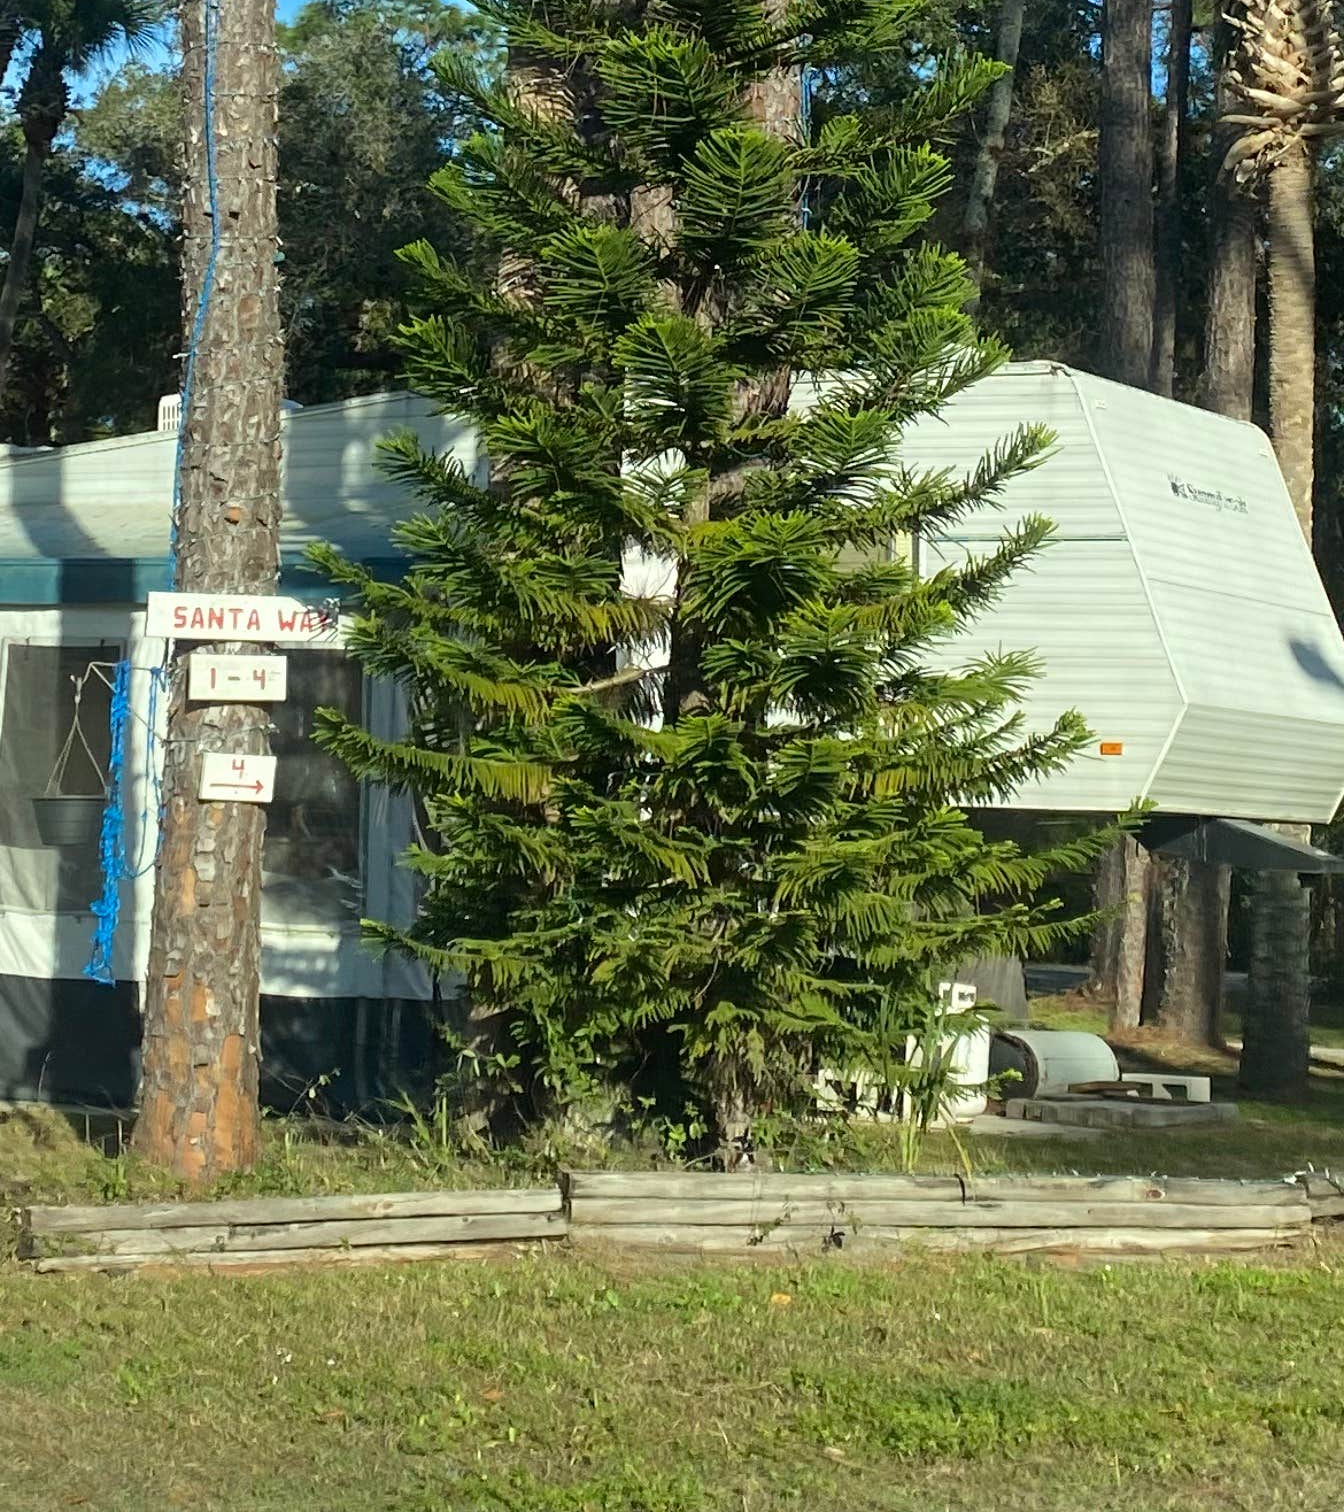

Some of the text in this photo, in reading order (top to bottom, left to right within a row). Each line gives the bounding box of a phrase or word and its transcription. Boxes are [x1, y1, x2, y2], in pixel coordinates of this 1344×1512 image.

[173, 606, 261, 631] SANTA
[252, 668, 266, 690] 4
[231, 759, 245, 778] 4
